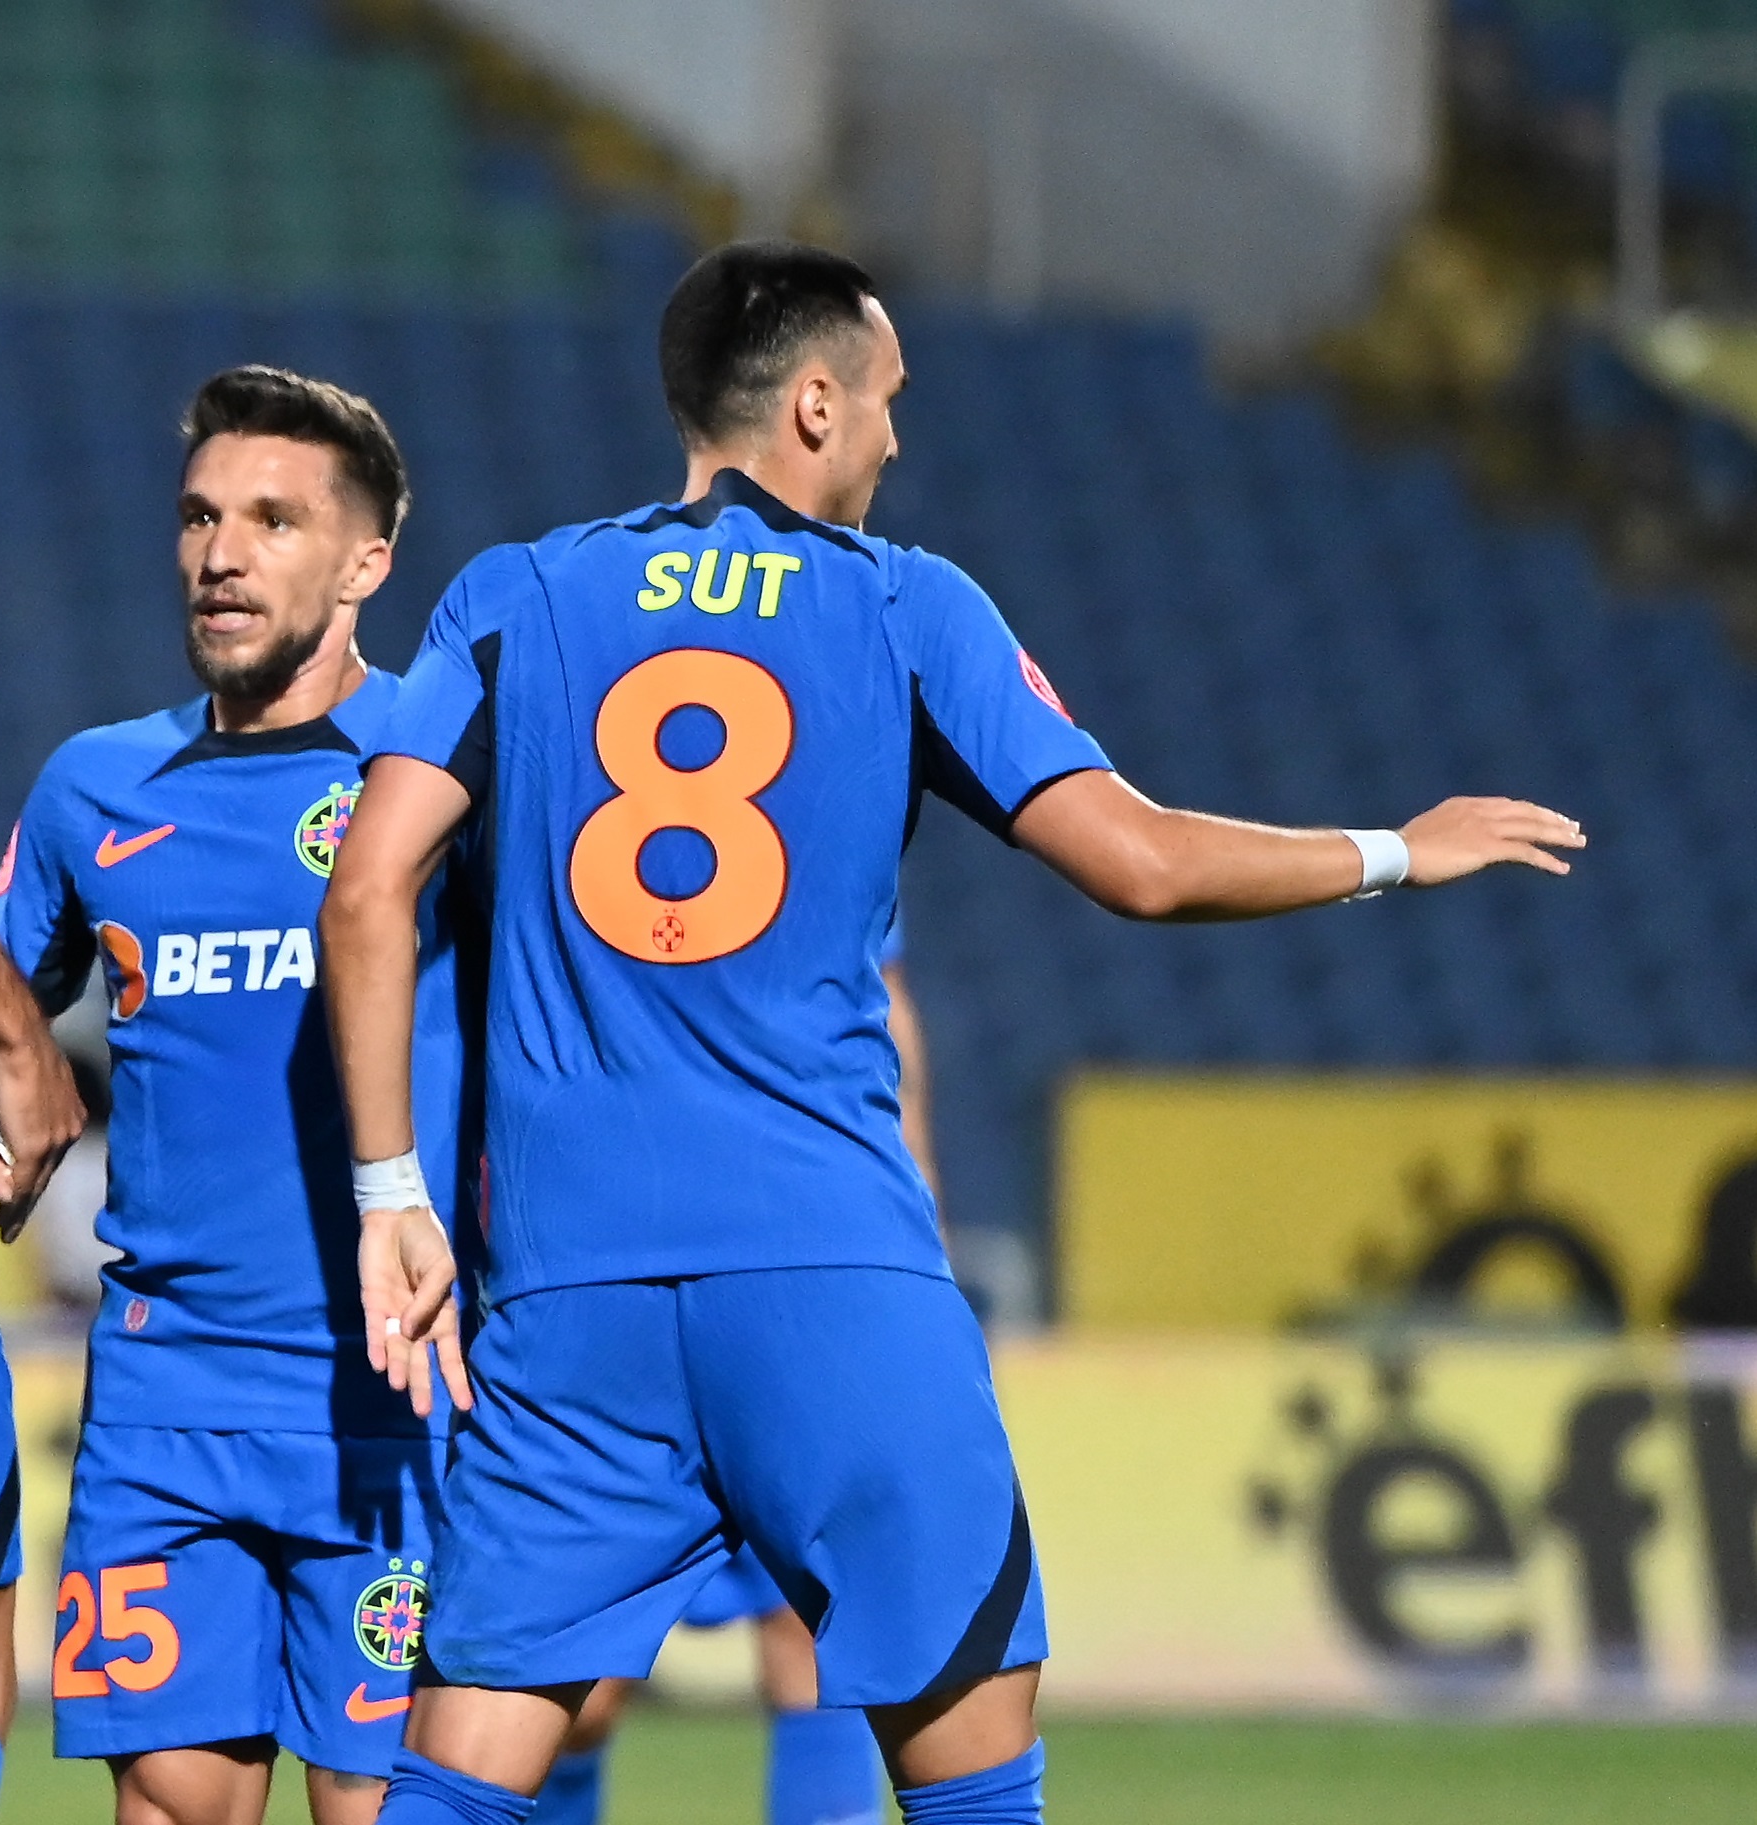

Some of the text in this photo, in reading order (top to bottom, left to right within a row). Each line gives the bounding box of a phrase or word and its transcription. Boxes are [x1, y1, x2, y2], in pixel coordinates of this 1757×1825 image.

[637, 548, 801, 618] SUT
[569, 646, 794, 964] 8
[153, 927, 317, 997] BETA
[52, 1561, 180, 1698] 25
